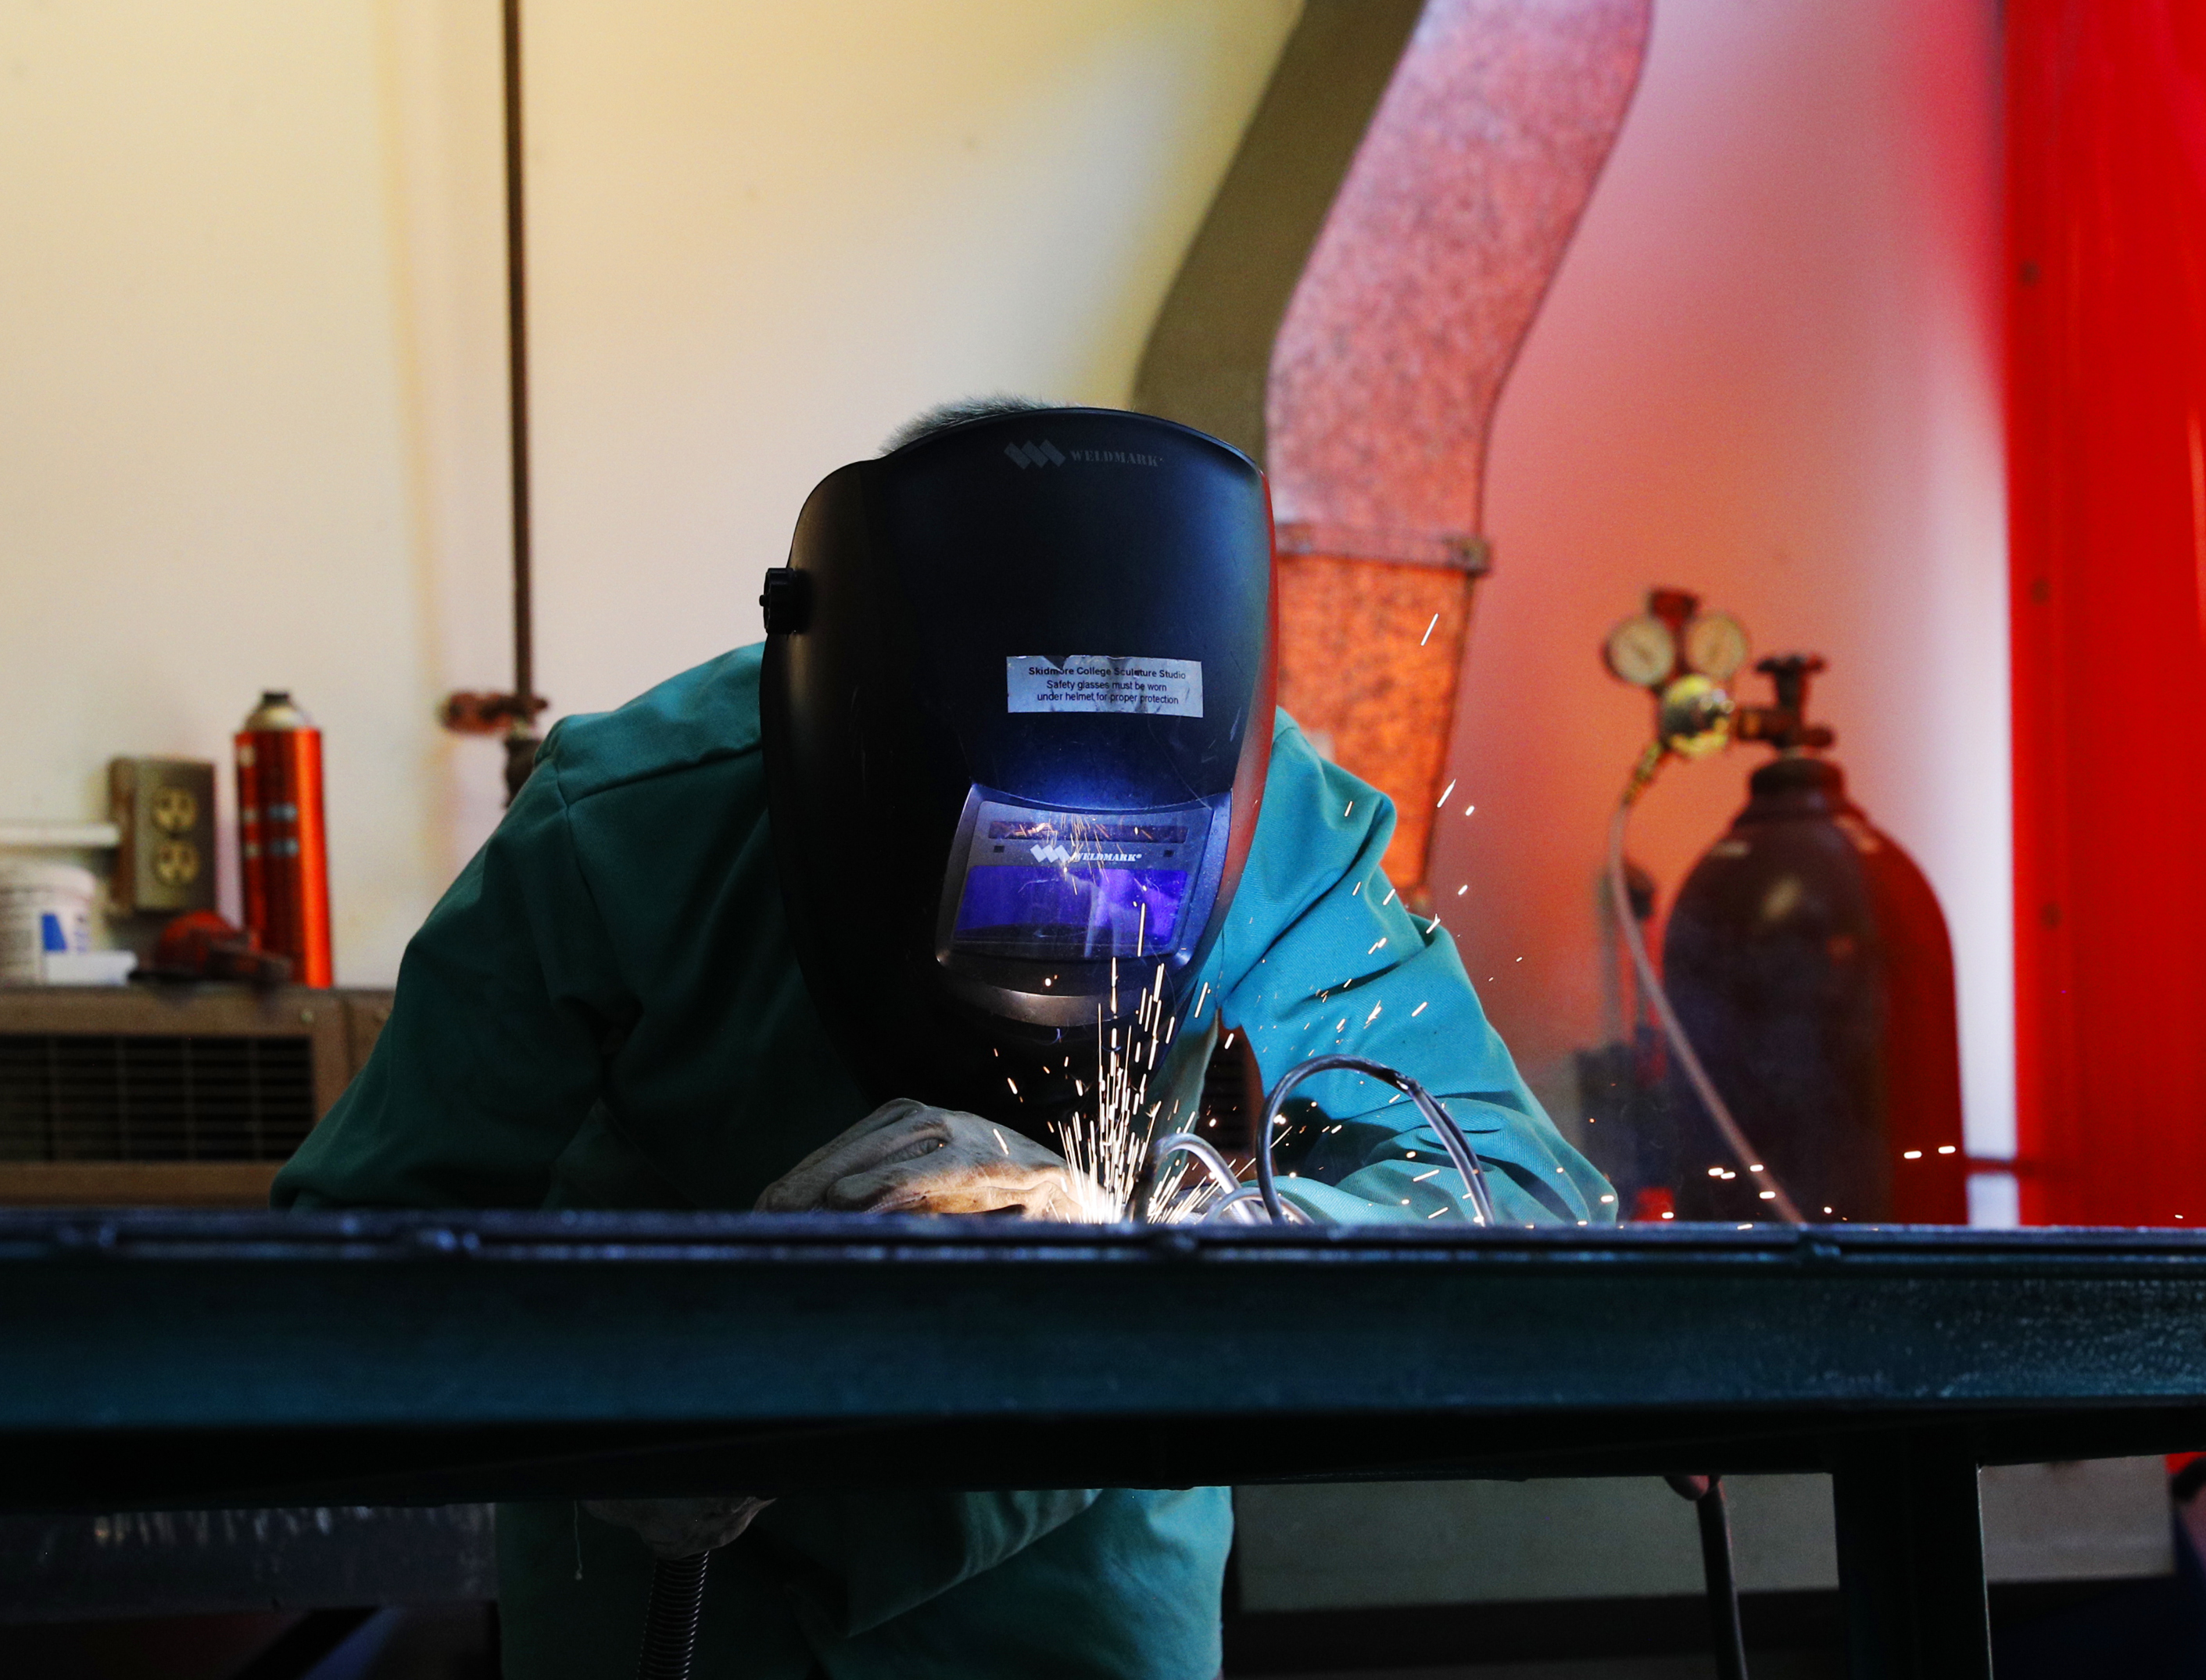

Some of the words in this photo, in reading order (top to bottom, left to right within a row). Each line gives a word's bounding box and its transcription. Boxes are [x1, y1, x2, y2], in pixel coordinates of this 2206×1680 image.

[1070, 450, 1158, 467] WELDMARK
[1077, 667, 1112, 677] College
[1114, 668, 1157, 678] Sculture
[1159, 670, 1186, 679] Studio
[1047, 680, 1075, 691] Safety
[1077, 681, 1109, 691] glasses
[1135, 682, 1144, 690] be
[1037, 693, 1062, 701] under
[1065, 693, 1094, 701] helmet
[1110, 694, 1137, 703] proper
[1140, 695, 1179, 704] protection
